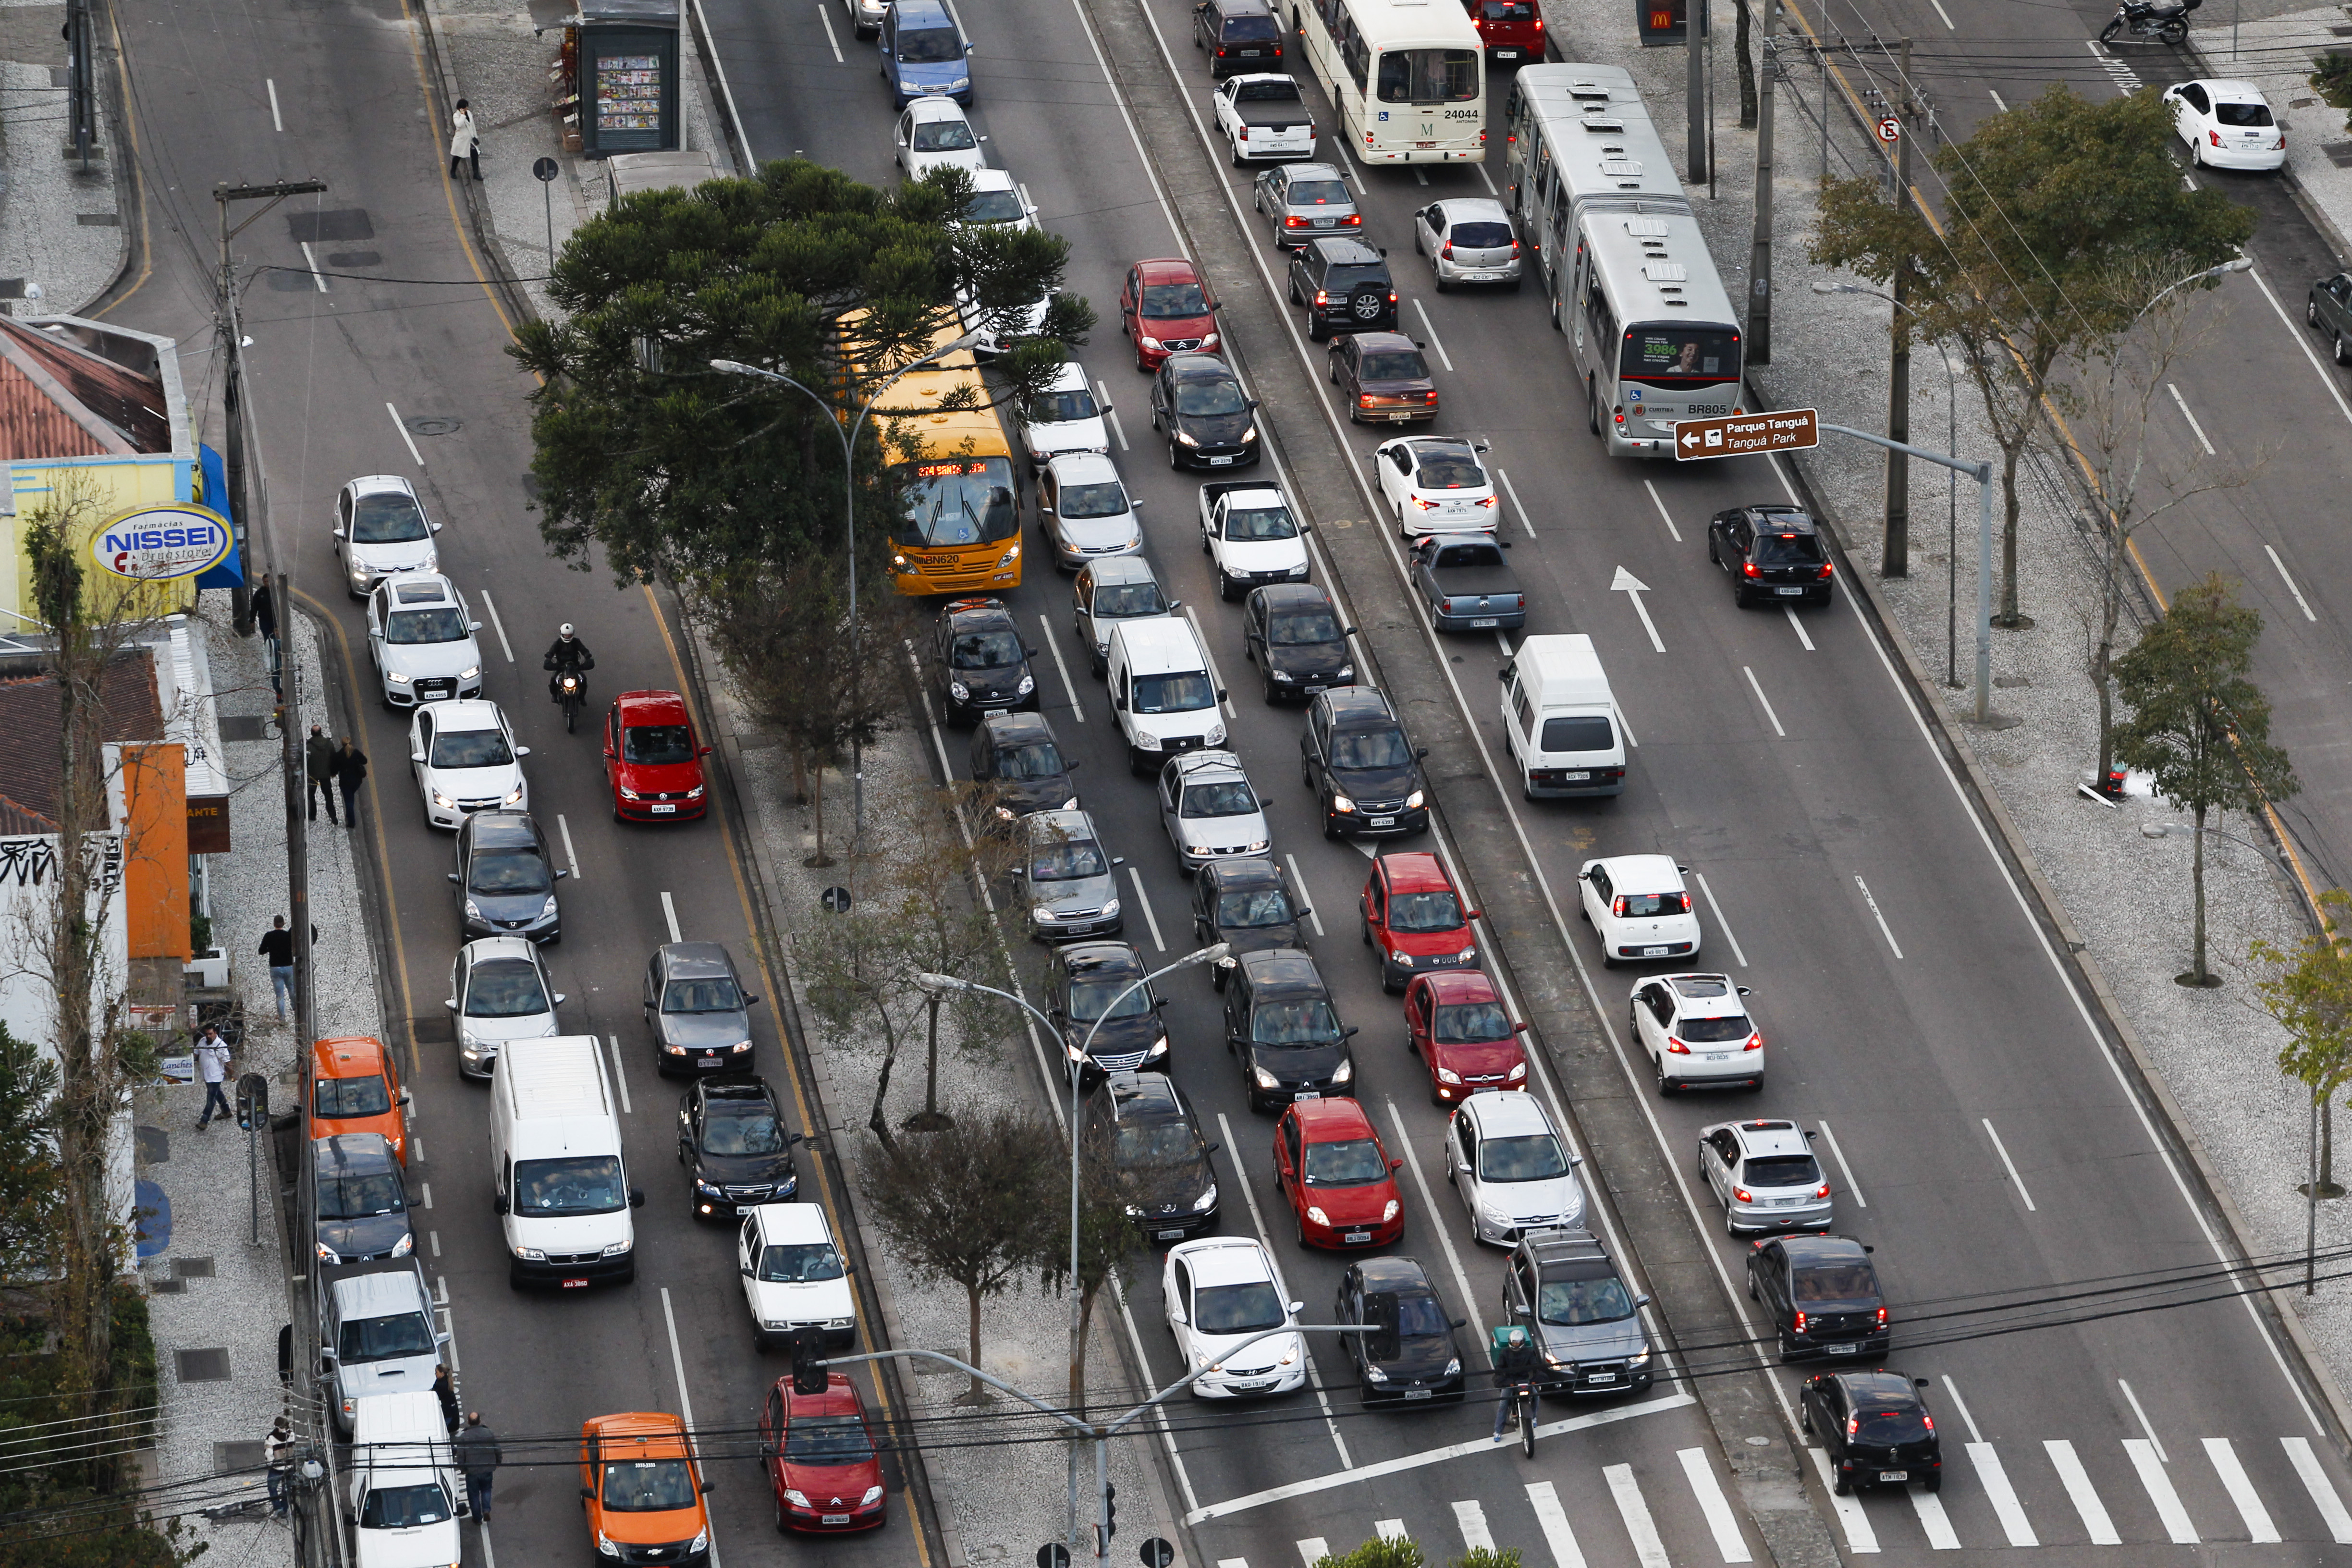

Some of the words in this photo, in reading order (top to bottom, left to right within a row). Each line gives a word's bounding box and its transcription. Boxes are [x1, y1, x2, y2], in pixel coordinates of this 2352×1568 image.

[2102, 59, 2143, 89] MOTOS
[1445, 110, 1478, 119] 24044
[1421, 123, 1433, 136] M
[1886, 123, 1894, 136] E
[1688, 405, 1726, 416] BR805
[1727, 424, 1765, 434] Parque
[1767, 416, 1808, 429] Tanguá
[1727, 436, 1766, 449] Tanguá
[1773, 432, 1796, 443] Park
[134, 521, 183, 530] Farmácias
[106, 527, 215, 552] NISSEI
[142, 548, 208, 562] Drugstore
[926, 554, 959, 564] BN620
[161, 1060, 193, 1069] Lanches
